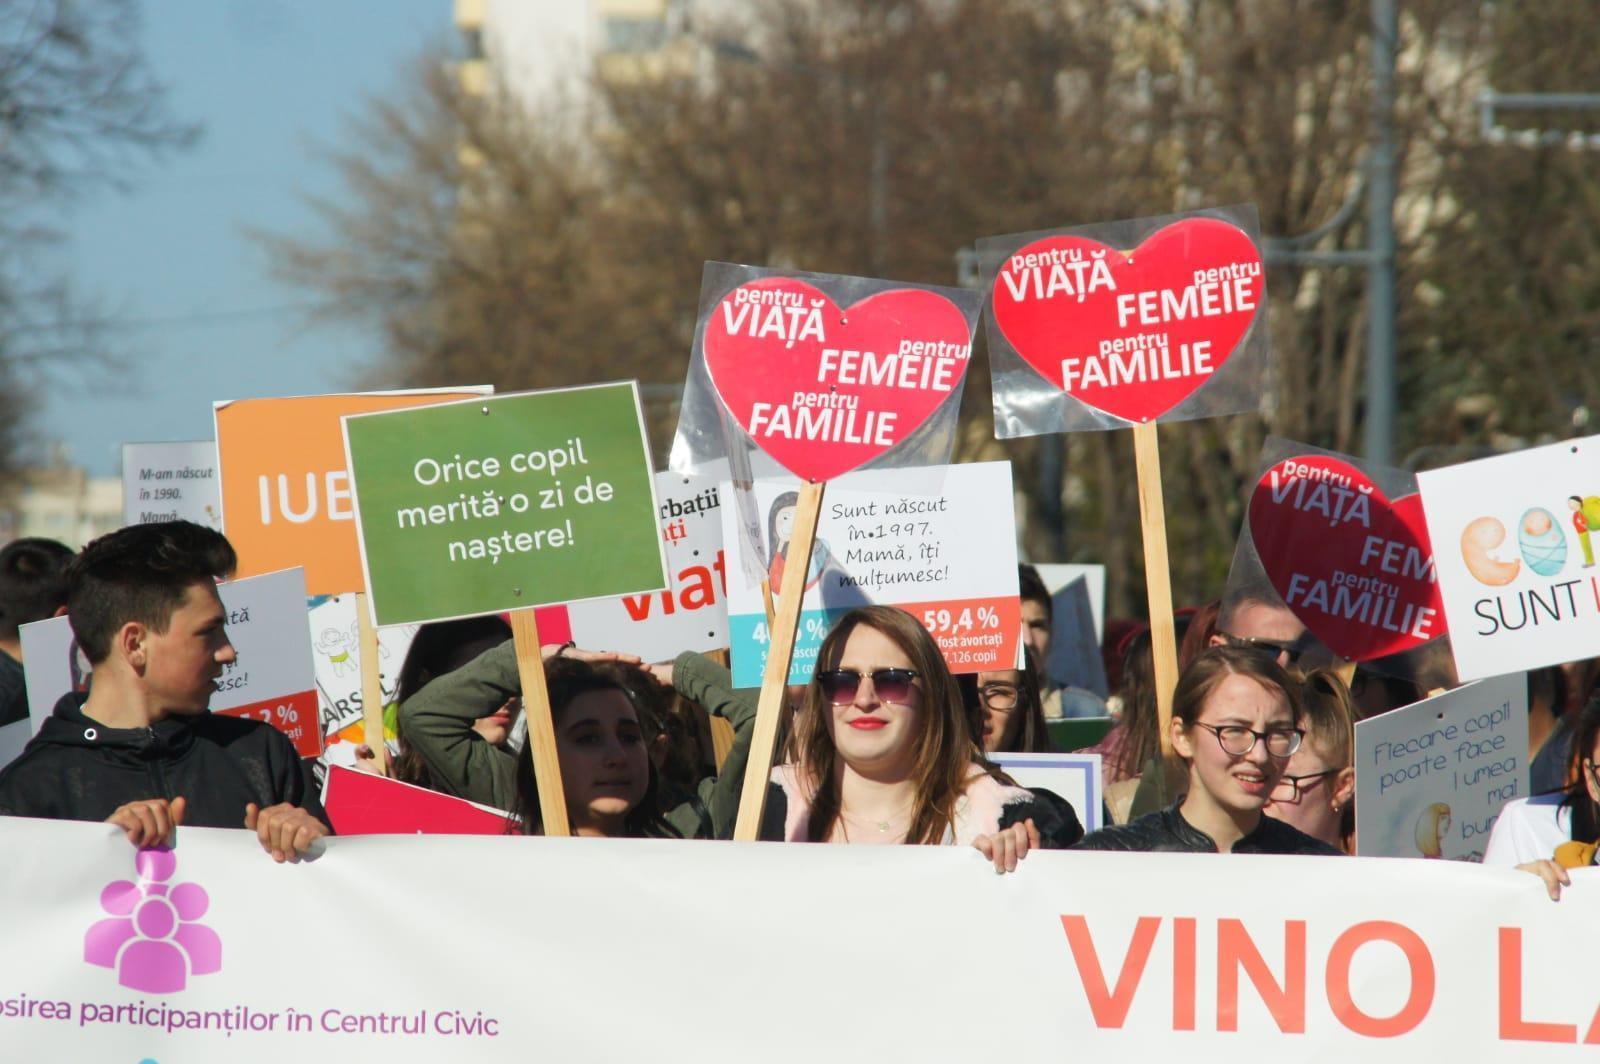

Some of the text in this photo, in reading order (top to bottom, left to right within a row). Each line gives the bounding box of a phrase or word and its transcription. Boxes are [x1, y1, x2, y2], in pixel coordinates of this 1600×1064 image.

[1011, 248, 1082, 273] pentru
[1193, 261, 1261, 287] pentru
[1001, 249, 1117, 303] VIAȚĂ
[735, 287, 804, 307] pentru
[1116, 277, 1256, 328] FEMEIE
[723, 299, 826, 349] VIAȚĂ
[898, 338, 971, 359] pentru
[1099, 332, 1169, 358] pentru
[817, 348, 956, 391] FEMEIE
[1061, 340, 1214, 392] FAMILIE
[792, 390, 859, 410] pentru
[749, 402, 898, 446] FAMILIE
[139, 468, 173, 480] M-am
[414, 437, 588, 486] Orice copil
[1282, 460, 1352, 489] pentru
[154, 487, 182, 500] 1990.
[397, 475, 614, 528] merită o zi de
[832, 497, 948, 520] Sunt născut
[449, 519, 575, 565] naștere!
[848, 522, 933, 541] în 1997.
[846, 541, 940, 565] Mamă, îți
[1360, 535, 1438, 584] FEM
[840, 565, 949, 591] mulțumesc!
[1331, 569, 1400, 599] pentru
[924, 606, 999, 634] 59,4 %
[1286, 573, 1436, 640] FAMILIE
[1474, 579, 1582, 636] SUNT
[937, 634, 958, 648] fost
[973, 649, 997, 664] copii
[1374, 701, 1511, 766] Fiecare copil
[1379, 734, 1506, 795] poate face
[1487, 778, 1519, 805] mai
[1060, 914, 1436, 1038] VINO
[79, 1000, 280, 1038] participanților
[286, 1007, 313, 1032] în
[320, 1009, 427, 1034] Centrul
[434, 1010, 499, 1037] Civic
